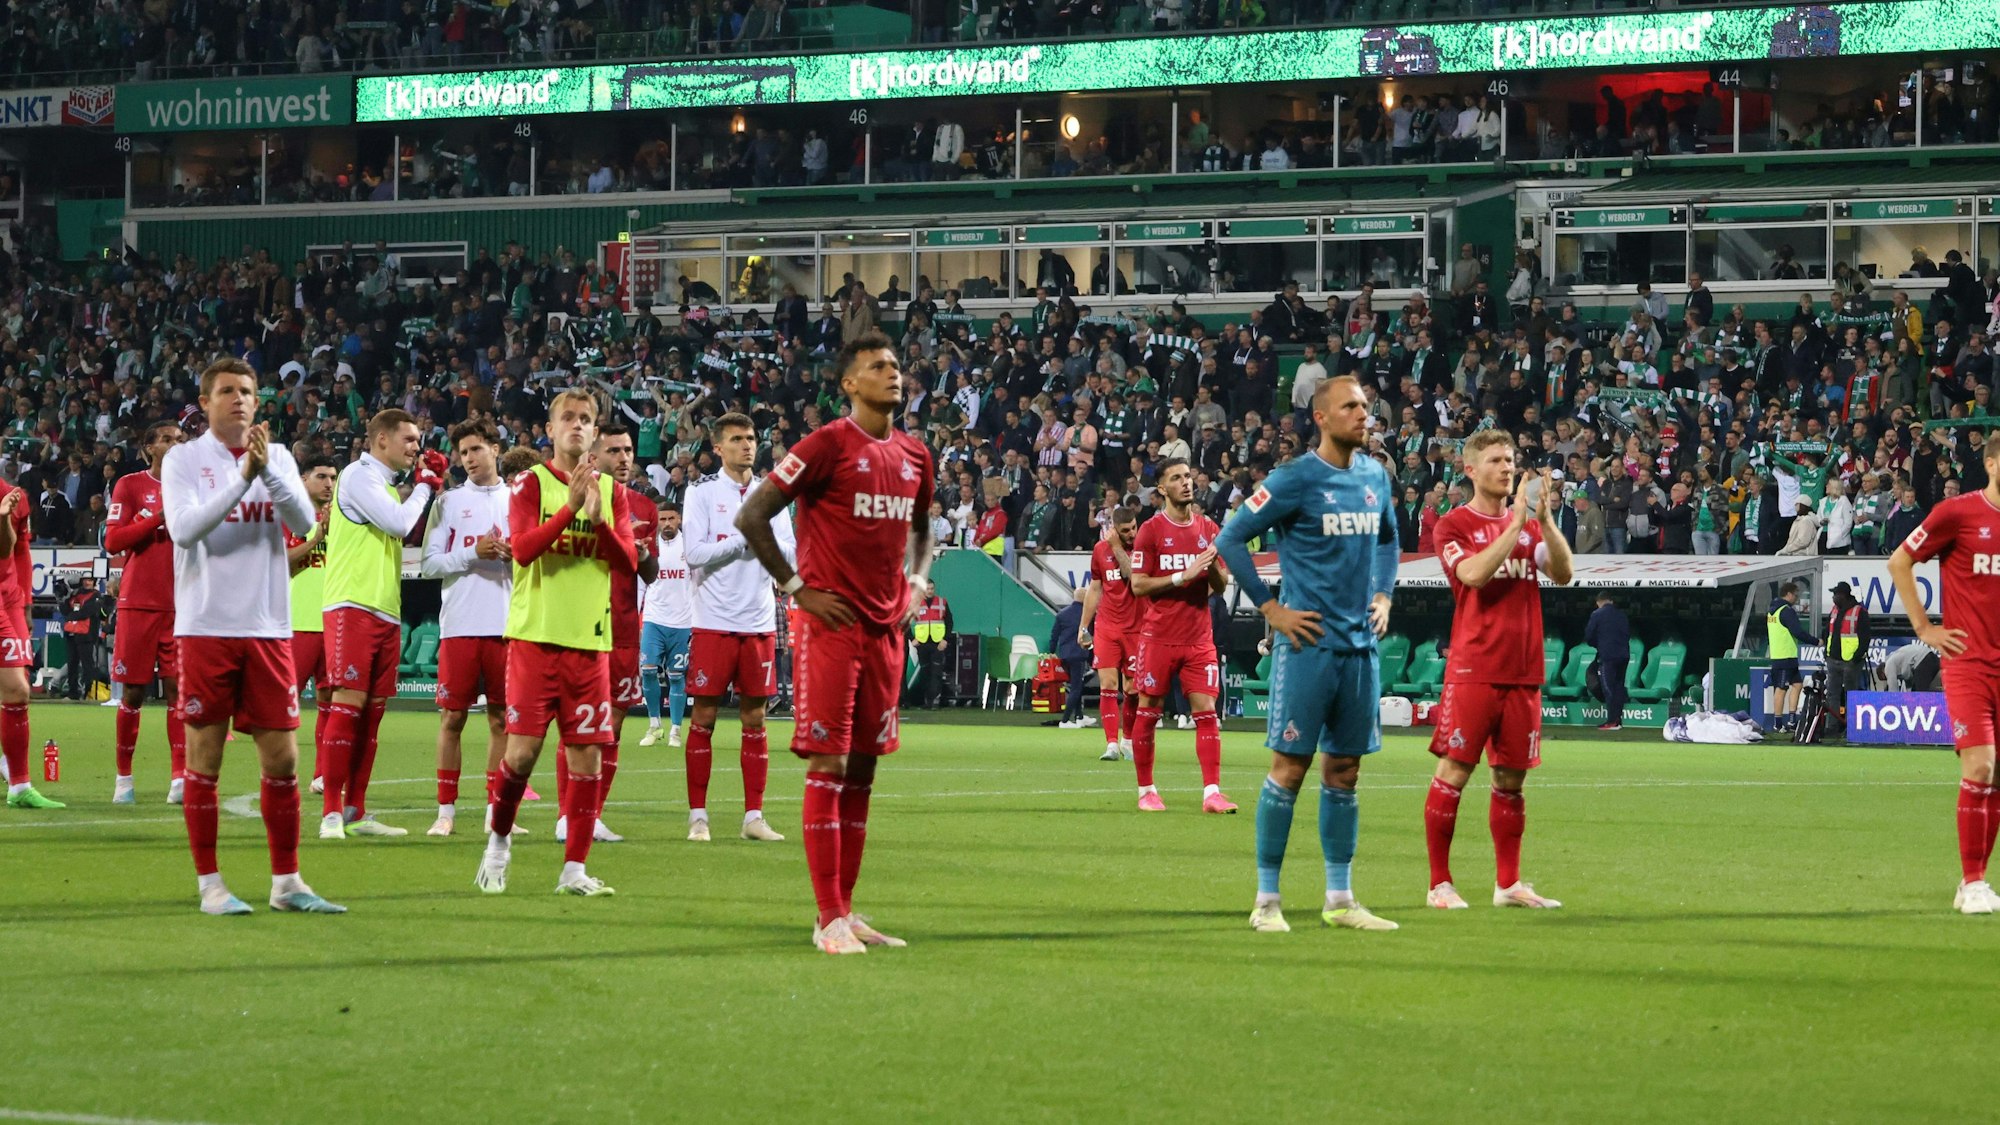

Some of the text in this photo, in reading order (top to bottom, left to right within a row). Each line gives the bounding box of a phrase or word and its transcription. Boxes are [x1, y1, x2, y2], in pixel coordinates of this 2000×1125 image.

[1718, 70, 1741, 86] 44
[1487, 79, 1508, 96] 46
[147, 84, 331, 127] wohninvest
[849, 108, 868, 124] 46
[514, 122, 531, 137] 48
[114, 136, 131, 152] 48
[1480, 253, 1490, 265] 46
[209, 478, 215, 489] 3
[225, 501, 275, 523] EWE
[853, 492, 916, 522] REWE
[1322, 512, 1380, 536] REWE
[1159, 554, 1208, 571] REW
[1973, 553, 2000, 576] RE
[1106, 570, 1122, 581] RE
[46, 620, 61, 634] VILS
[1801, 646, 1826, 661] VILS
[761, 661, 773, 687] 7
[1204, 663, 1219, 688] 17
[395, 680, 438, 692] ohninves
[617, 675, 642, 702] 23
[287, 684, 299, 718] 3
[575, 700, 613, 734] 22
[1856, 704, 1942, 732] now.
